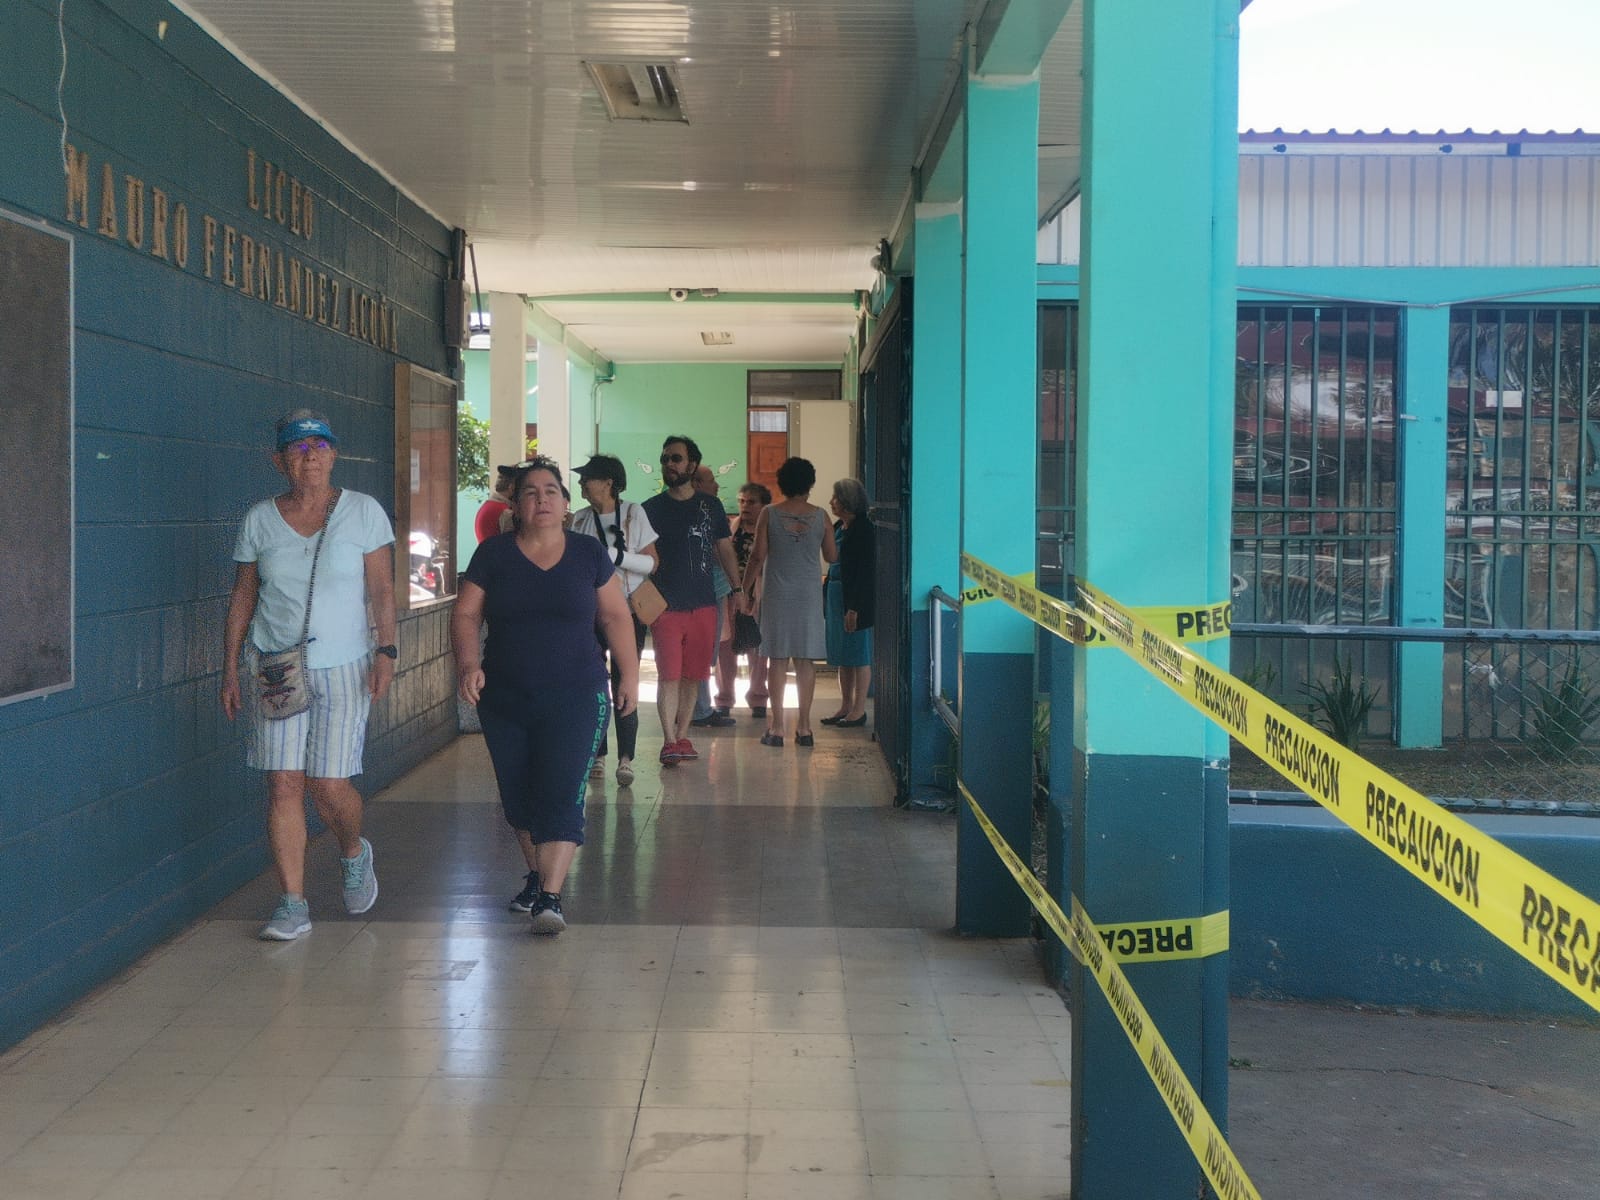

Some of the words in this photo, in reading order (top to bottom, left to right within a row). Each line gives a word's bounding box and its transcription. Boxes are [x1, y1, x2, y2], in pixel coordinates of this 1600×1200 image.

[64, 143, 189, 268] MAURO
[203, 215, 341, 329] FERNANDEZ
[349, 288, 399, 354] ACUÑA
[247, 150, 314, 240] LICEO
[1194, 664, 1249, 738] PRECAUCION
[1264, 713, 1341, 807] PRECAUCION
[1365, 780, 1481, 909] PRECAUCION
